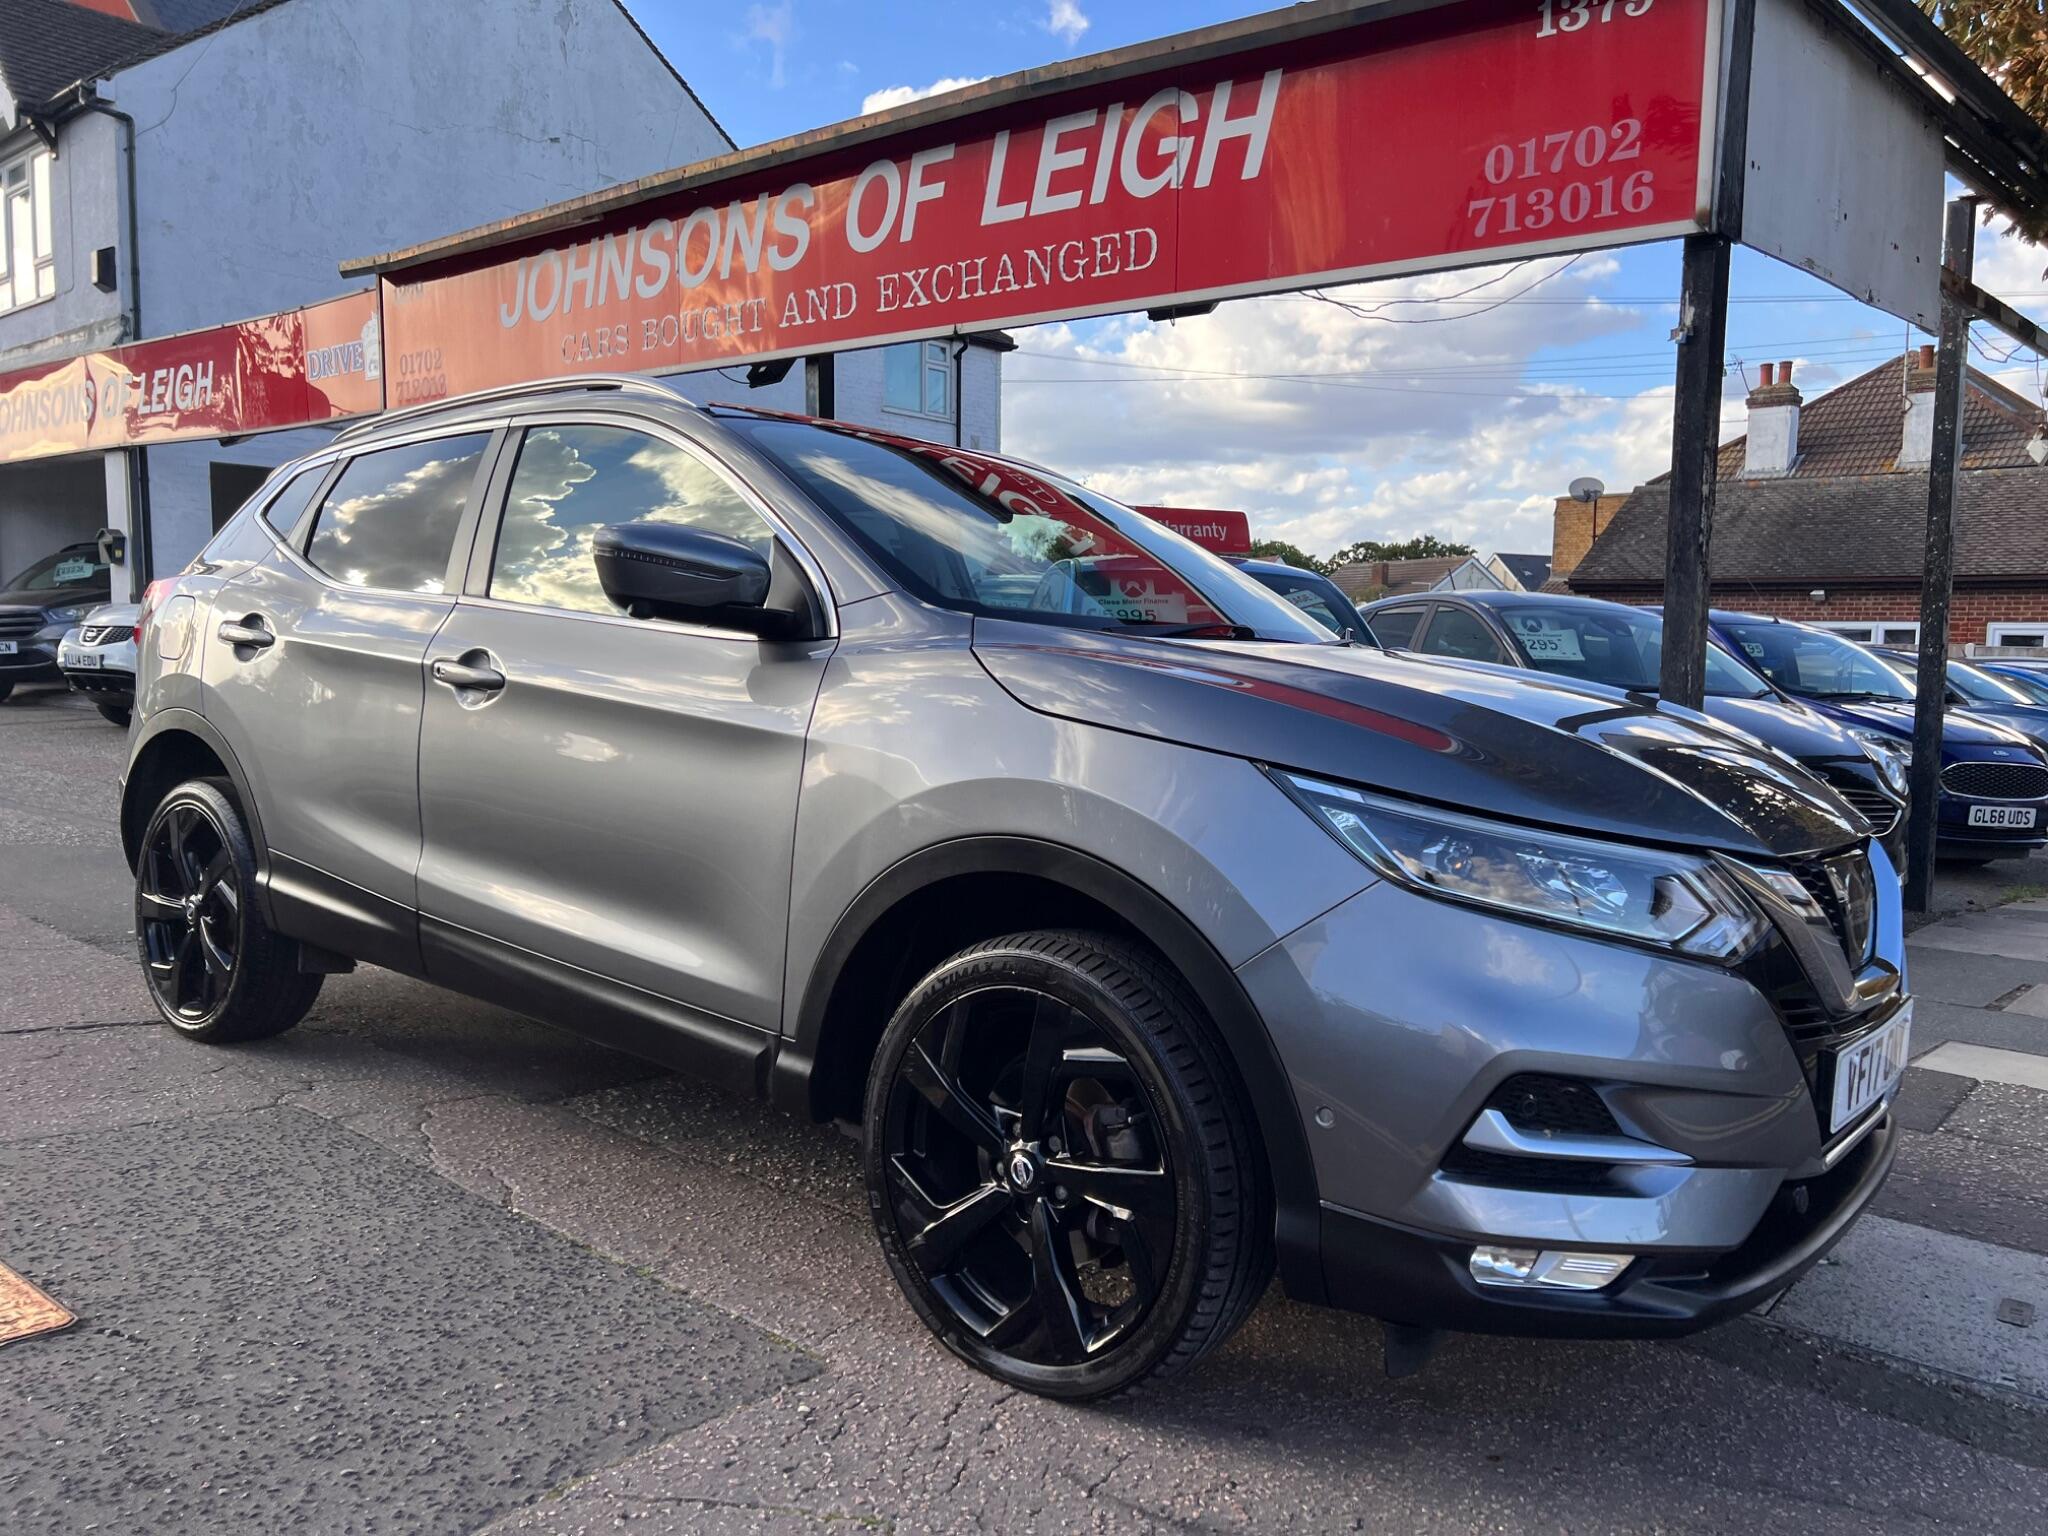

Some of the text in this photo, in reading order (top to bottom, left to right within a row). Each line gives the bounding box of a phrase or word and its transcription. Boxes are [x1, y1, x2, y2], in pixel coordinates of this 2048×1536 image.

[1484, 118, 1641, 184] 01702
[500, 68, 1284, 328] JOHNSONS OF LEIGH
[1467, 170, 1654, 238] 713016
[561, 227, 1158, 364] CARS BOUGHT AND EXCHANGED
[103, 373, 133, 419] OF
[137, 360, 214, 415] LEIGH
[307, 341, 365, 381] DRIVE
[400, 347, 442, 376] 01702
[1159, 519, 1228, 541] arranty
[1973, 808, 2031, 826] GL68 UDS
